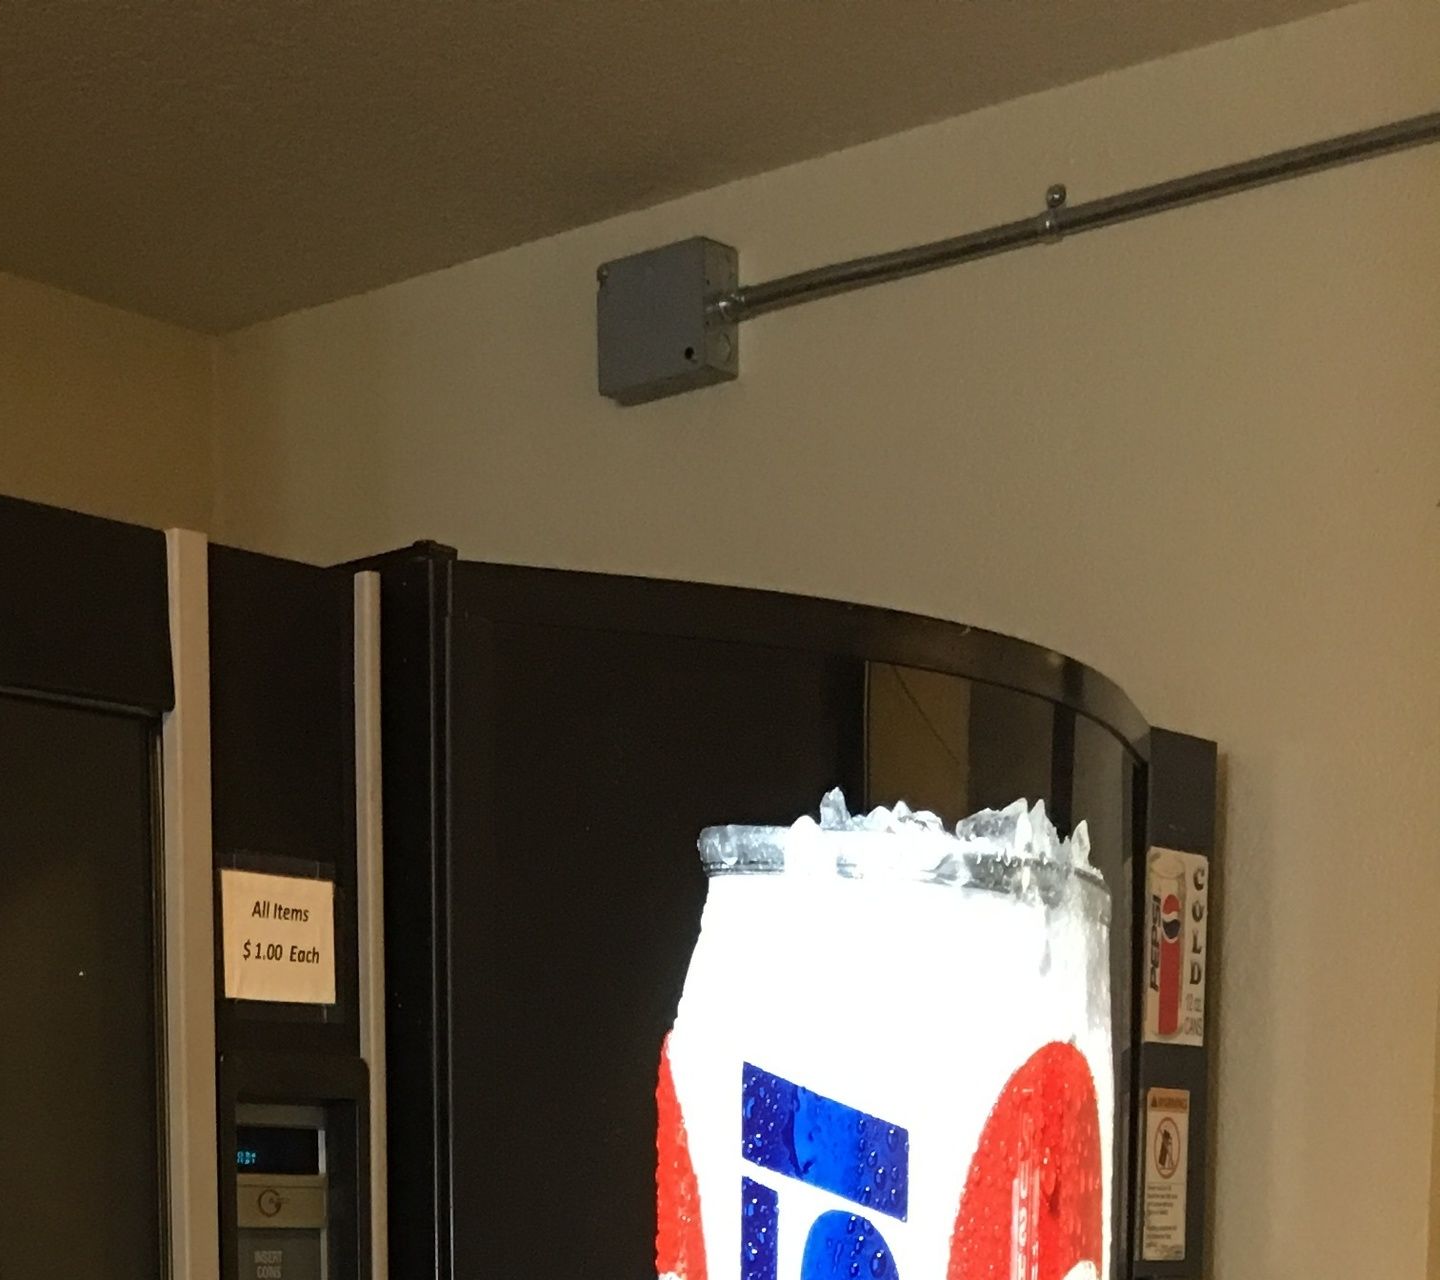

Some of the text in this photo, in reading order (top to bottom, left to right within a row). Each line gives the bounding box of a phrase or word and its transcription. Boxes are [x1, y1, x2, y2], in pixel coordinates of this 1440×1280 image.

[252, 901, 309, 922] All Items
[289, 945, 320, 964] Each
